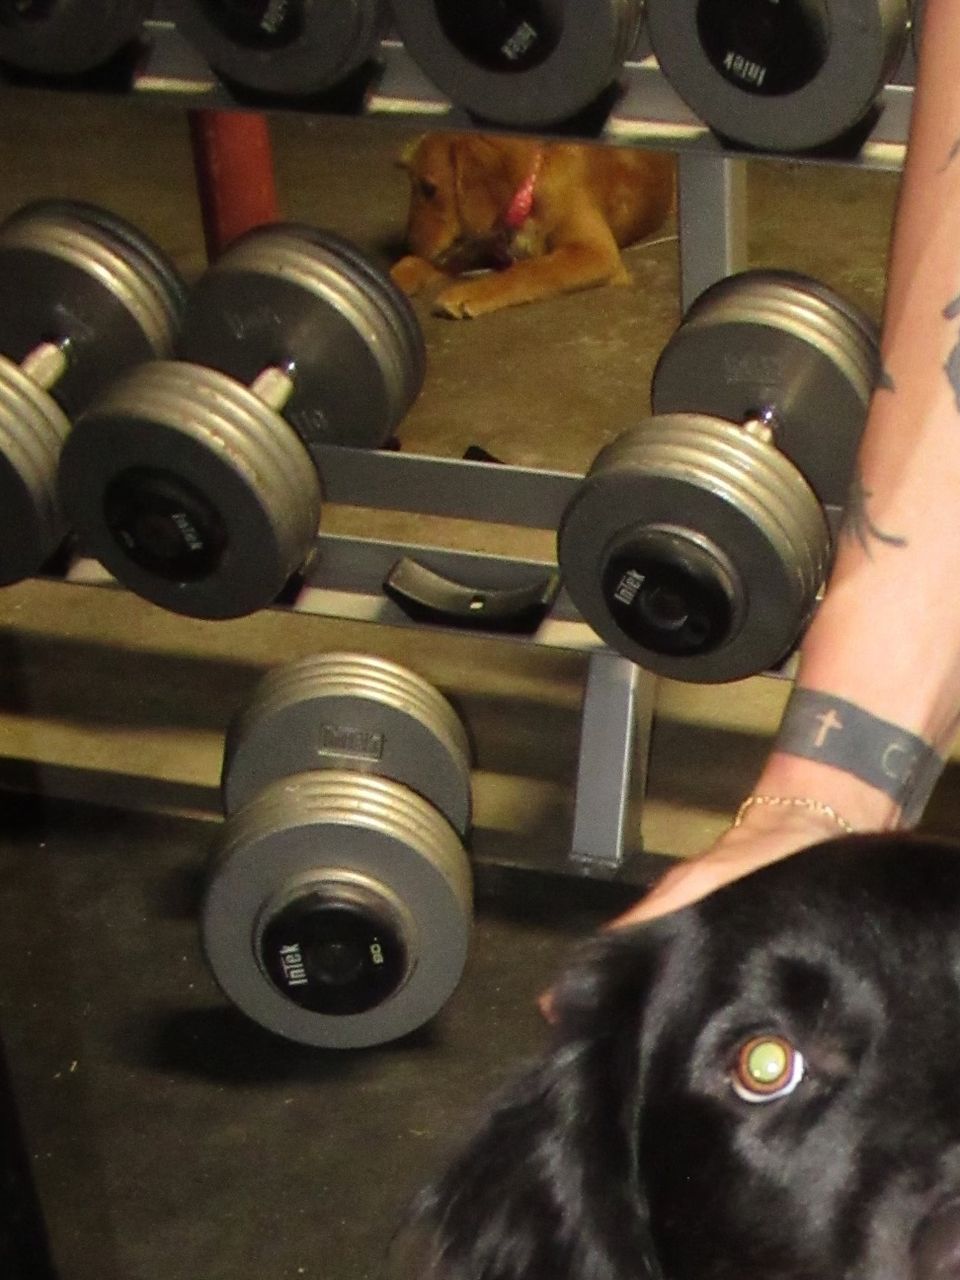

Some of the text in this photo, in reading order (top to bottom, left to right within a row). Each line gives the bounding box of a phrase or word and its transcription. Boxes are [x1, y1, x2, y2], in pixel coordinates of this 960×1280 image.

[723, 50, 767, 87] InTek
[613, 568, 646, 605] InTek
[279, 942, 309, 986] InTek
